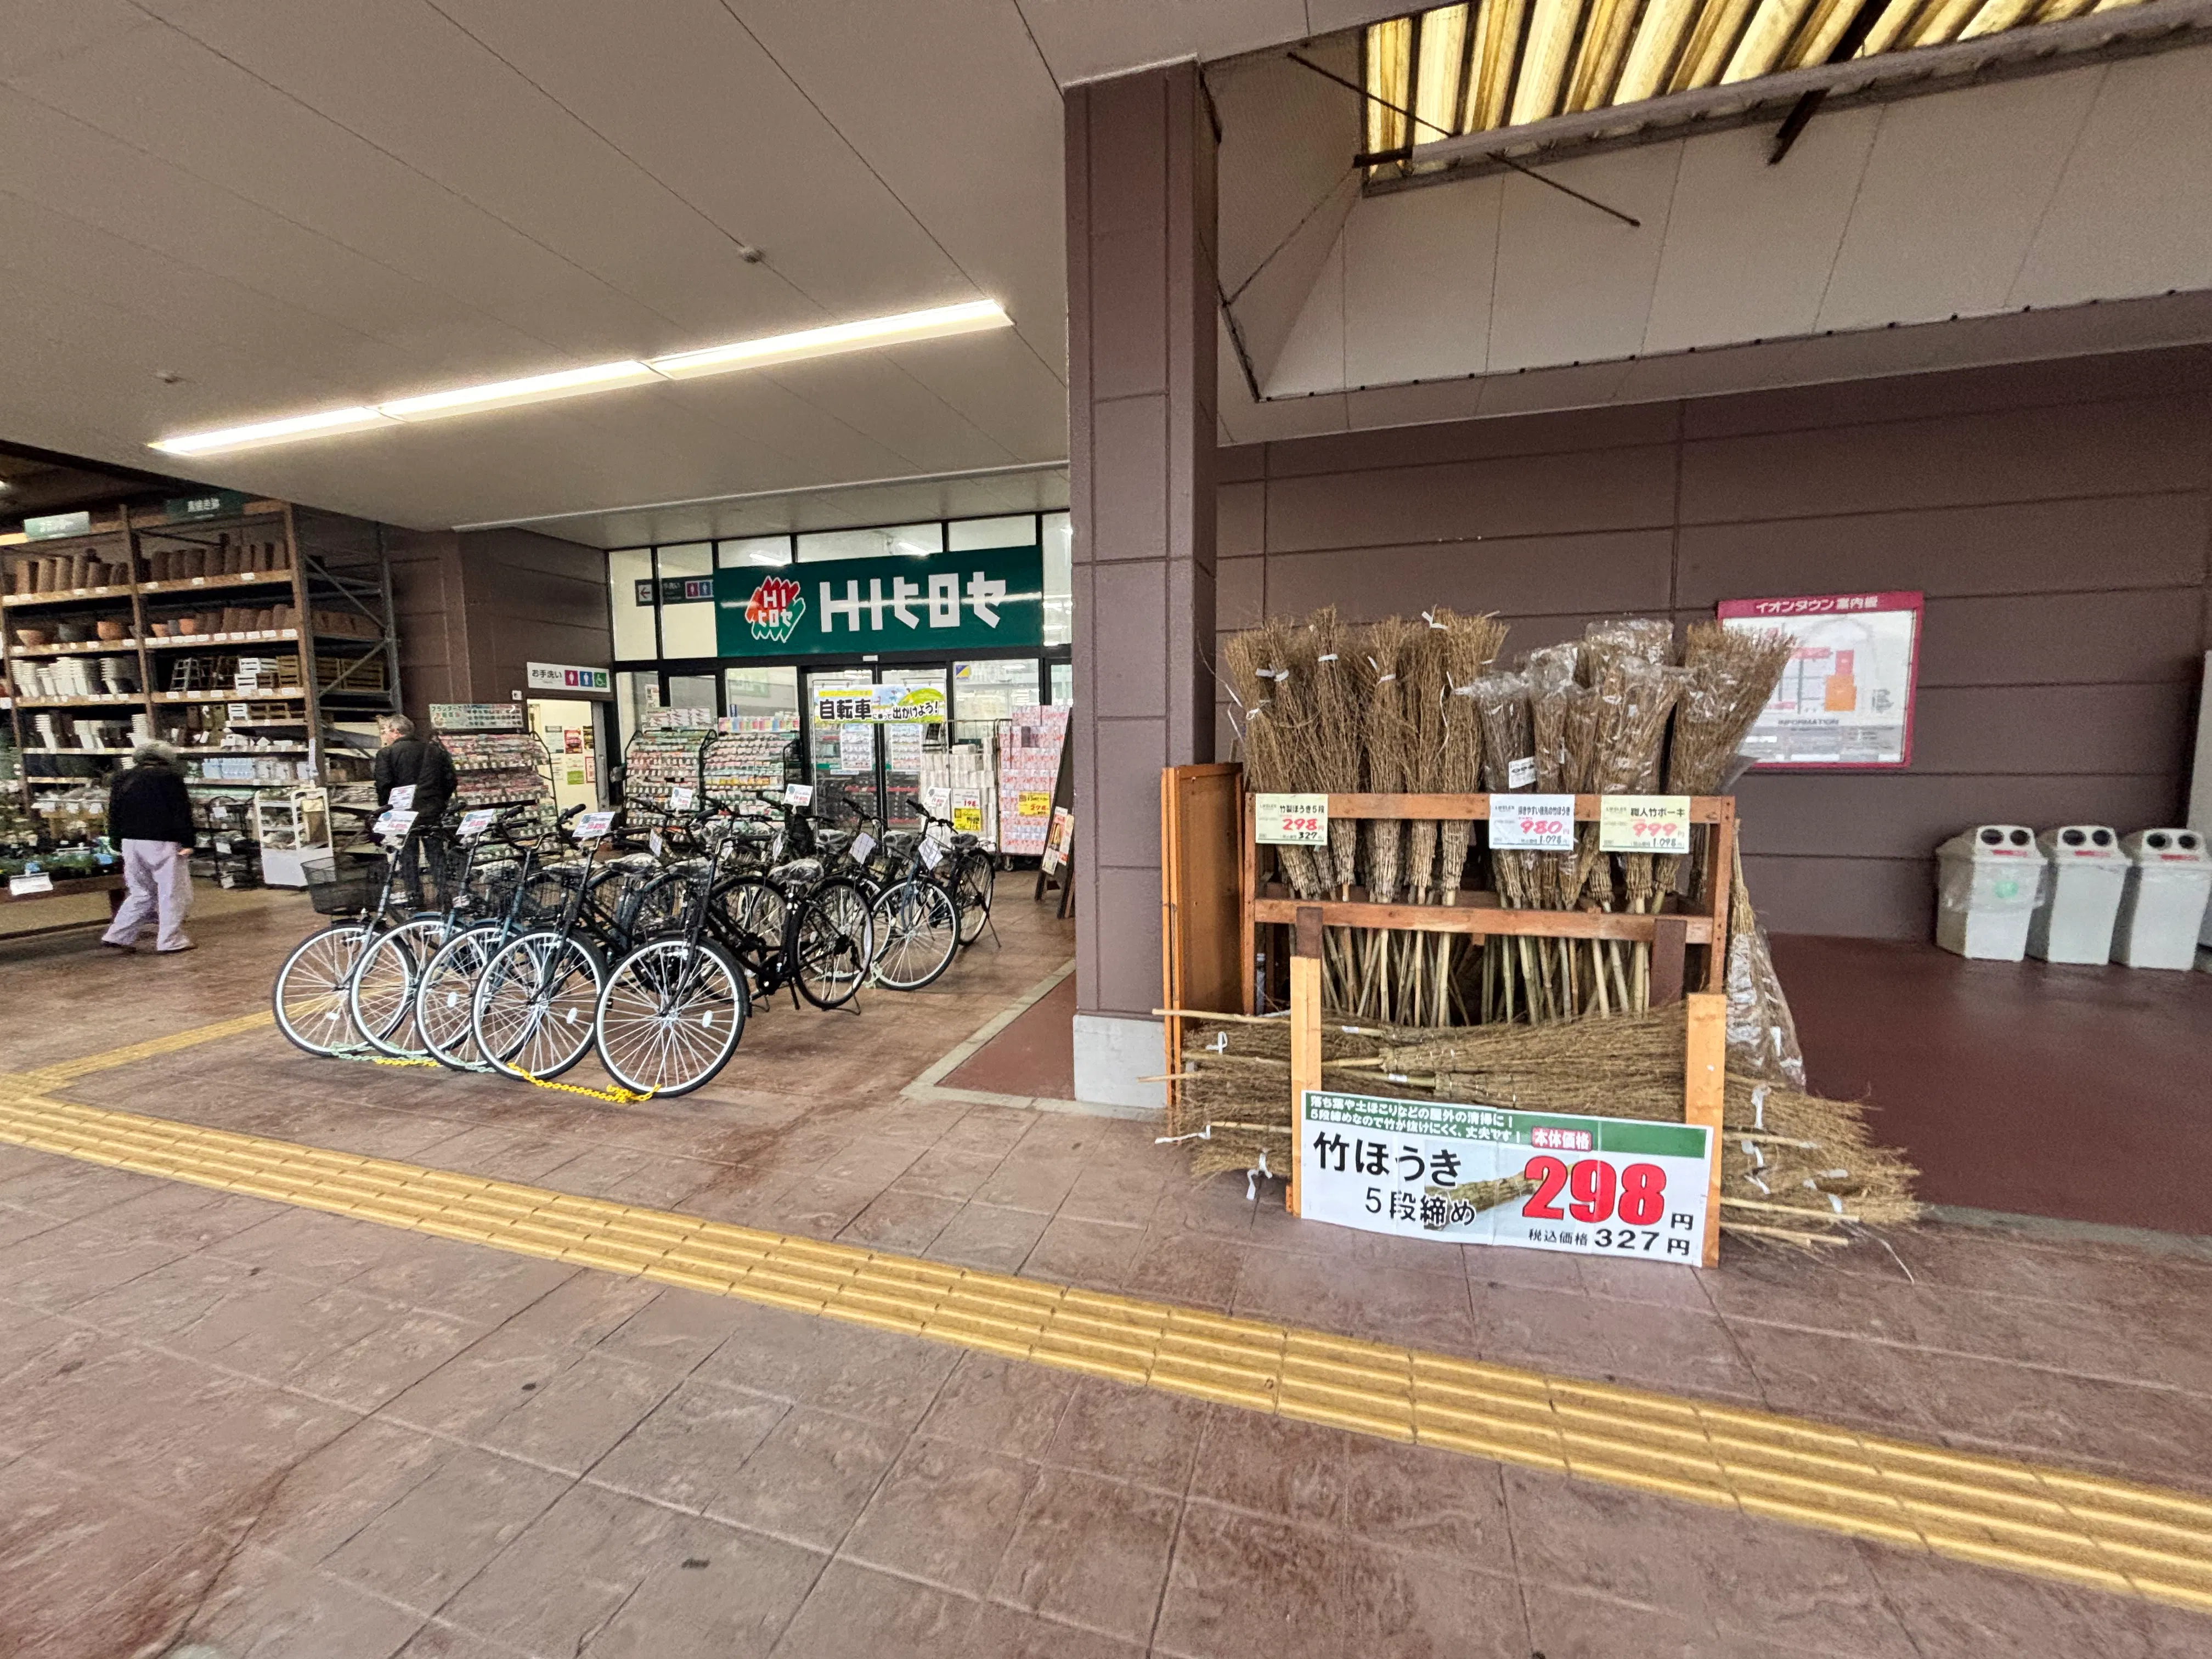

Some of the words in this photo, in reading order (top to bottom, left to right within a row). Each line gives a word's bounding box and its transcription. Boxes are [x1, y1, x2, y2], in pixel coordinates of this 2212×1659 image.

[763, 589, 786, 608] HI
[758, 609, 793, 628] ヒロセ
[532, 669, 562, 679] お手洗い
[1534, 1129, 1590, 1150] 本体価格
[1313, 1131, 1462, 1187] 竹ほうき
[1365, 1186, 1476, 1226] 5段締め
